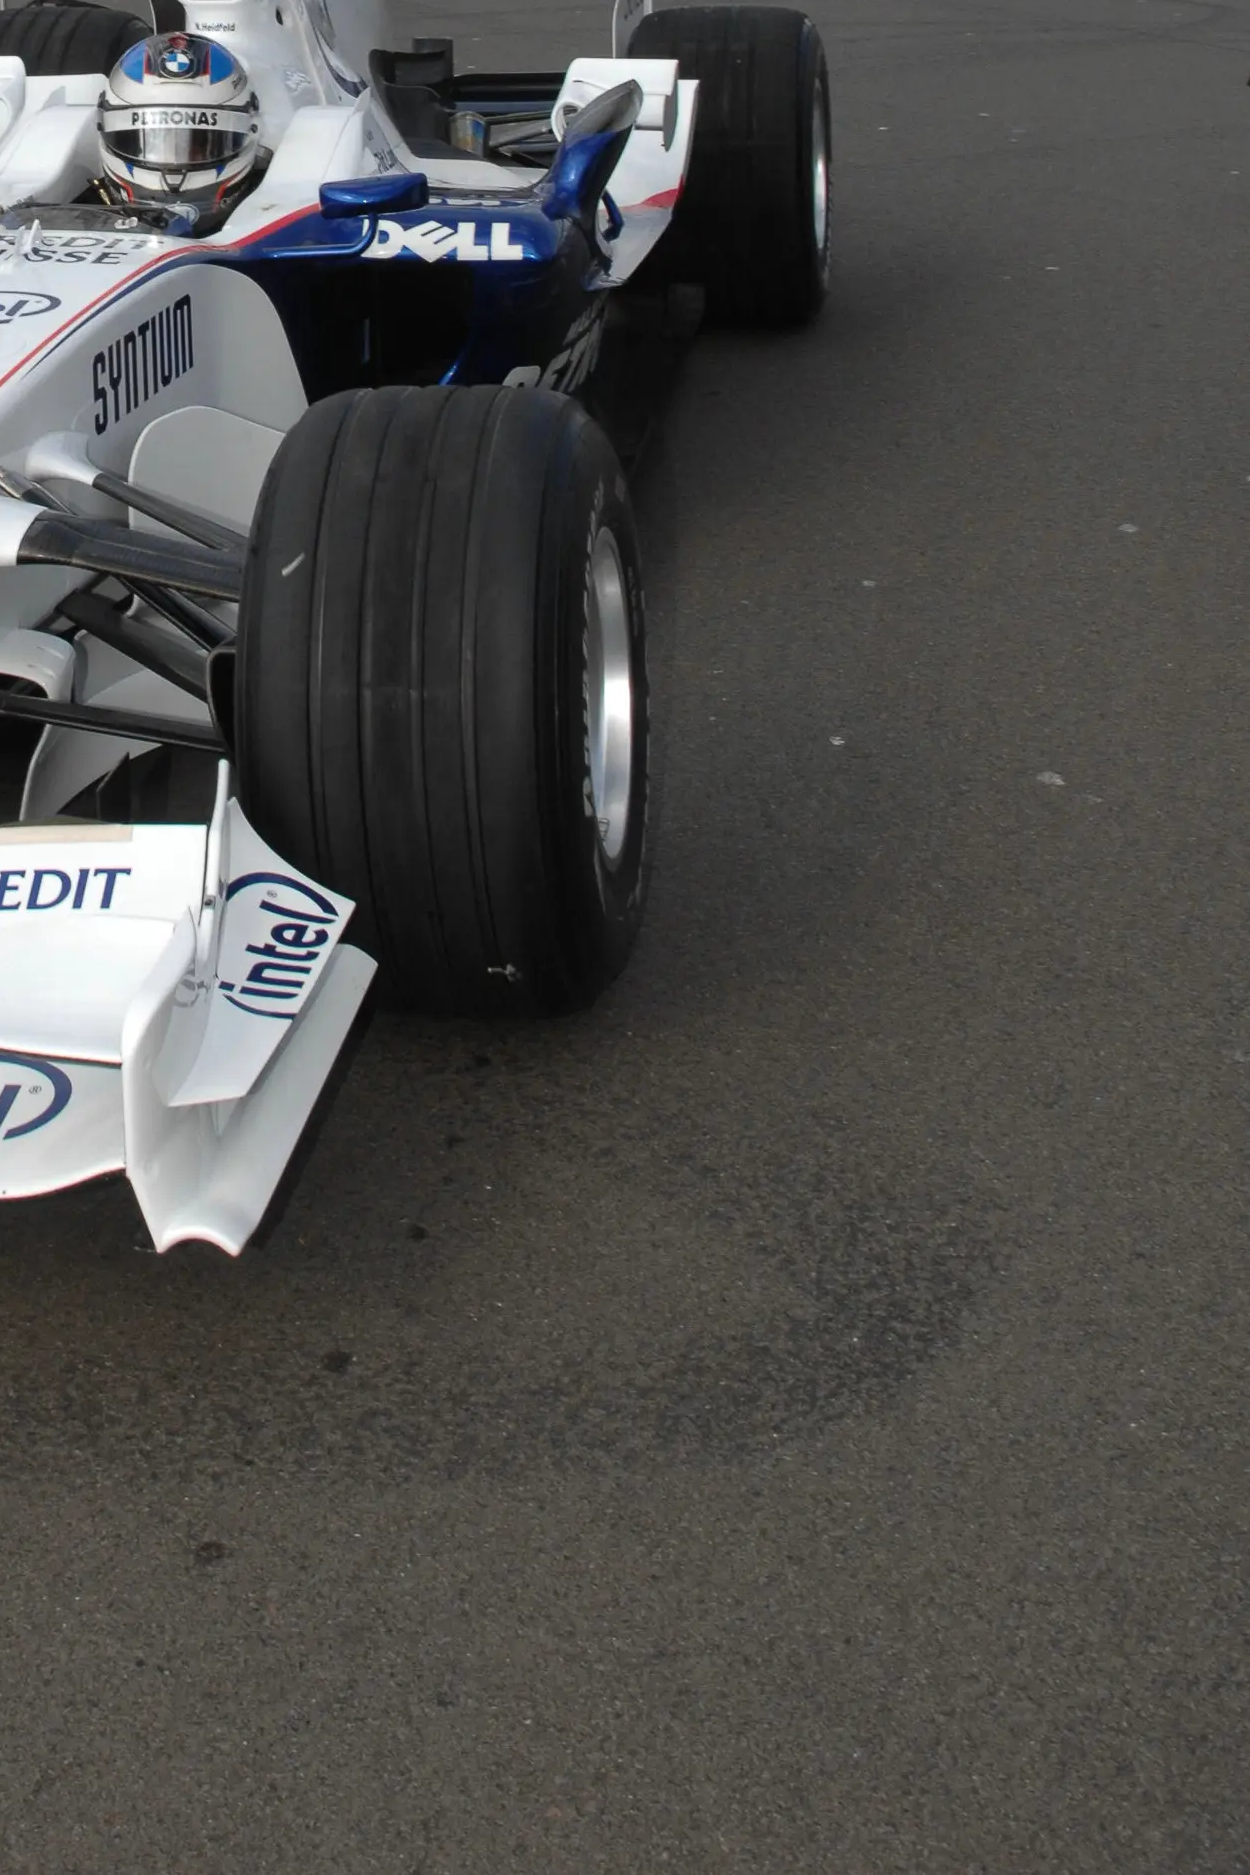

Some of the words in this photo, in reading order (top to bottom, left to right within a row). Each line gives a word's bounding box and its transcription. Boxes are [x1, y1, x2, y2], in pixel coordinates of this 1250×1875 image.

[131, 110, 218, 126] PETRONAS
[360, 218, 523, 263] DELL
[92, 293, 194, 436] SYNTIUM
[218, 899, 337, 999] intel
